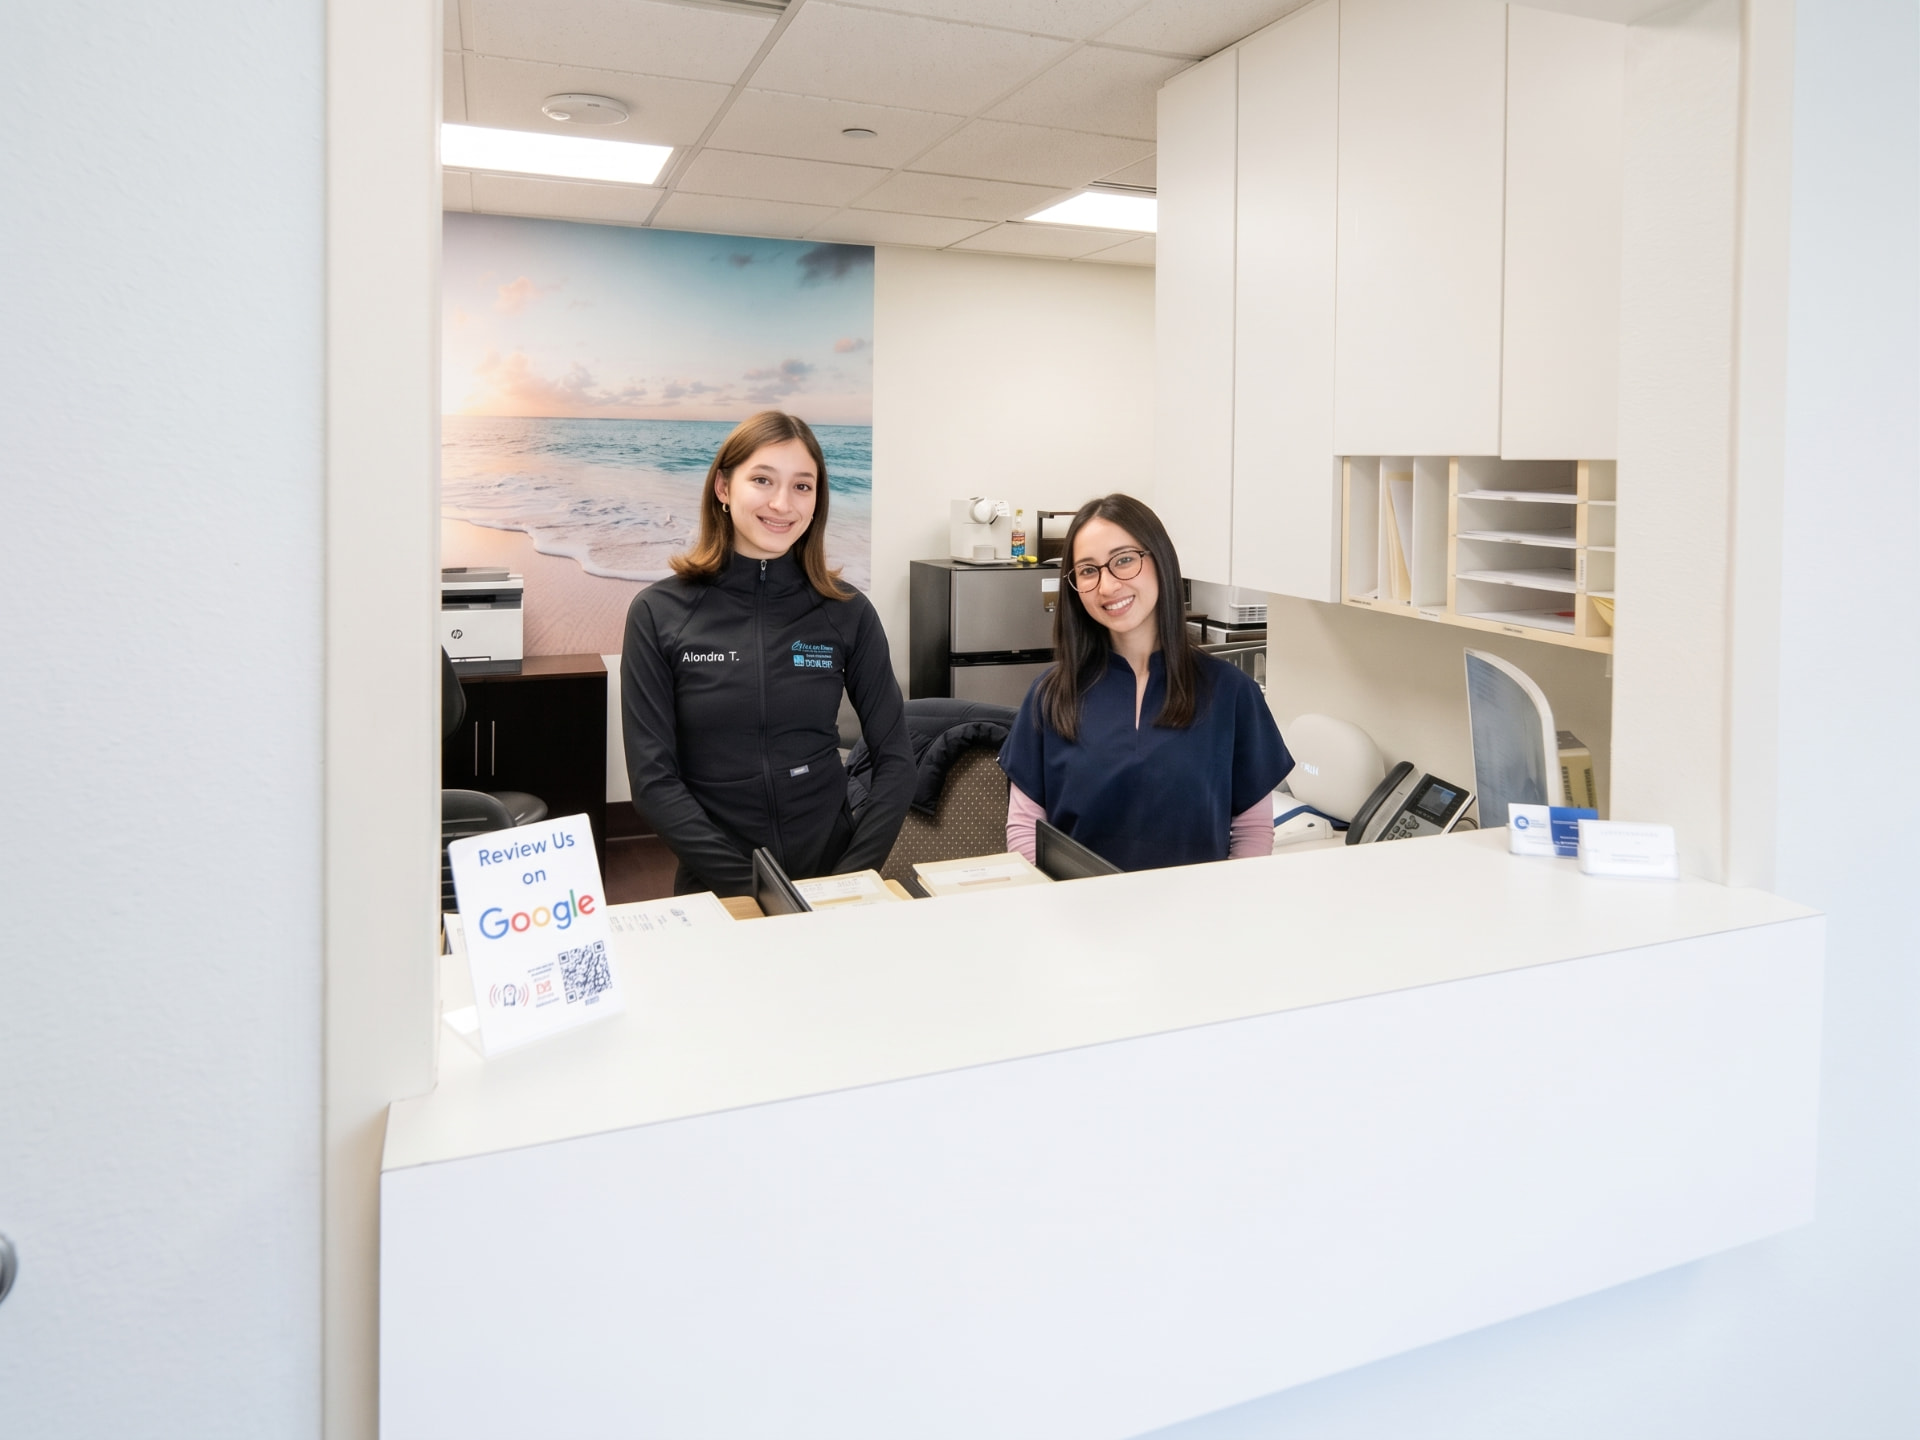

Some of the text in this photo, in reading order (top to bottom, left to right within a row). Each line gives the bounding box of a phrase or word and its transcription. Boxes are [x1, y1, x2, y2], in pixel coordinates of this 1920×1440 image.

[682, 651, 740, 662] Alondra T.
[478, 832, 575, 866] Review Us
[522, 869, 546, 885] on
[479, 889, 595, 939] Google
